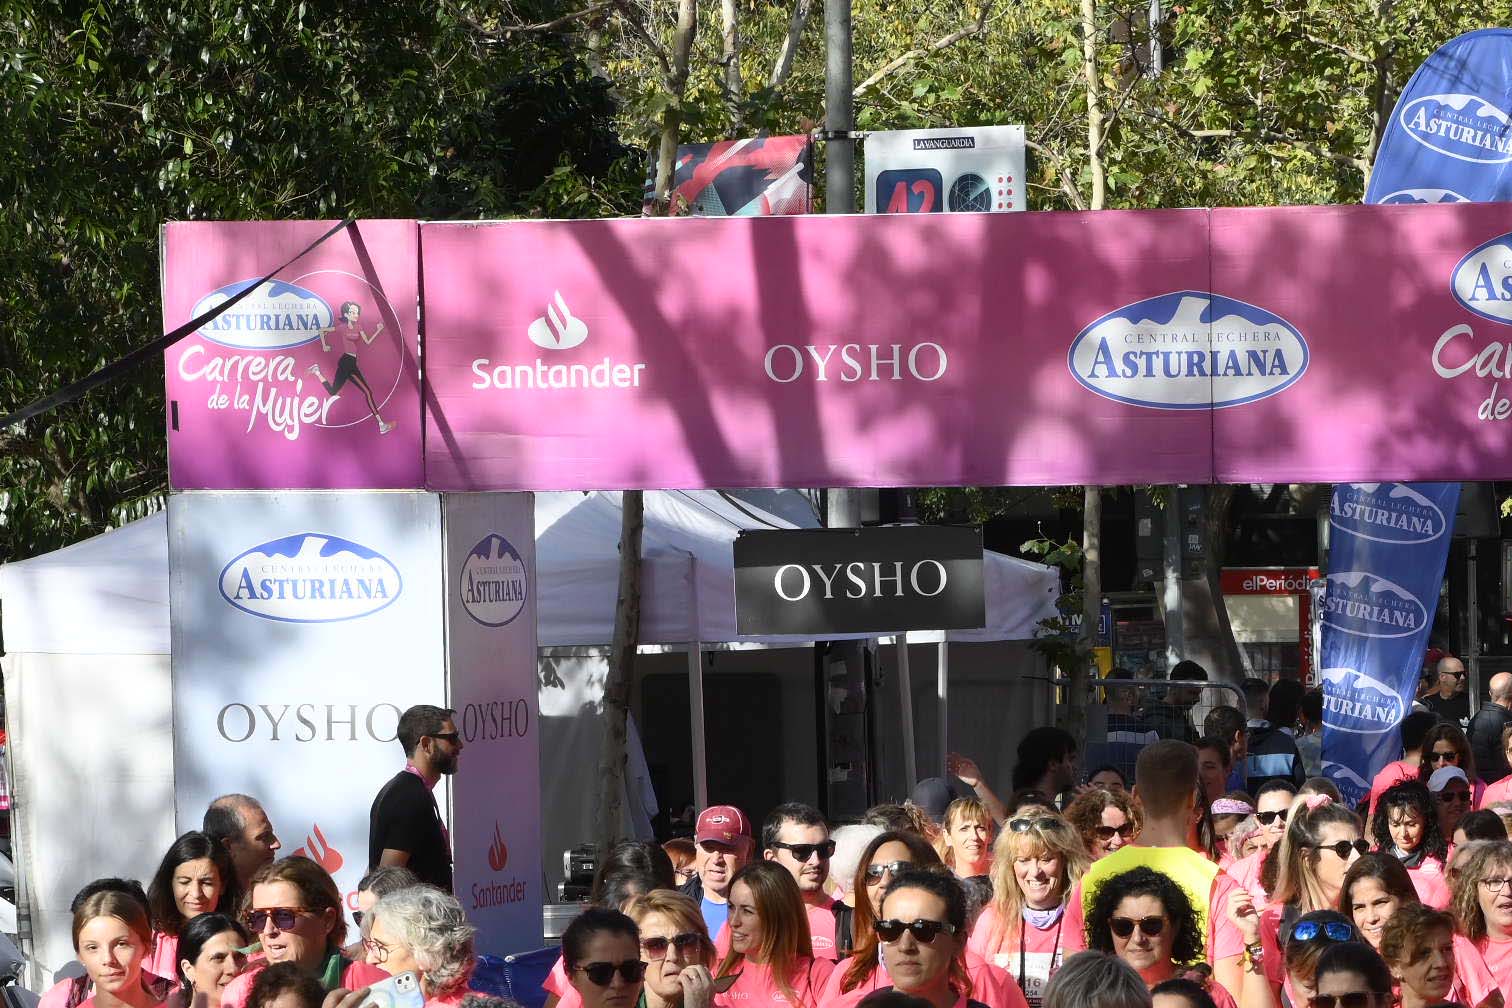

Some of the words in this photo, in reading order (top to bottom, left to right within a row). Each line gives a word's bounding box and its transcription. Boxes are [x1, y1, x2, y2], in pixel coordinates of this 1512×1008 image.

[204, 309, 321, 331] ASTURIANA
[1125, 333, 1199, 344] CENTRAL
[1205, 331, 1282, 342] LECHERA
[178, 344, 296, 383] Carrera
[473, 357, 645, 390] Santander
[765, 342, 948, 383] OYSHO
[1087, 336, 1290, 380] ASTURIANA
[208, 383, 230, 410] de
[234, 384, 249, 409] la
[247, 378, 341, 440] Mujer
[1478, 383, 1512, 421] de
[1330, 491, 1434, 535] ASTURIANA
[234, 566, 389, 601] ASTURIANA
[465, 570, 523, 604] ASTURIANA
[774, 559, 948, 602] OYSHO
[1243, 575, 1318, 591] elPeriódi
[1325, 595, 1416, 629] STURIANA
[217, 703, 400, 743] OYSHO
[463, 699, 529, 743] OYSHO
[1323, 696, 1396, 723] TURIANA
[472, 880, 526, 911] Santander
